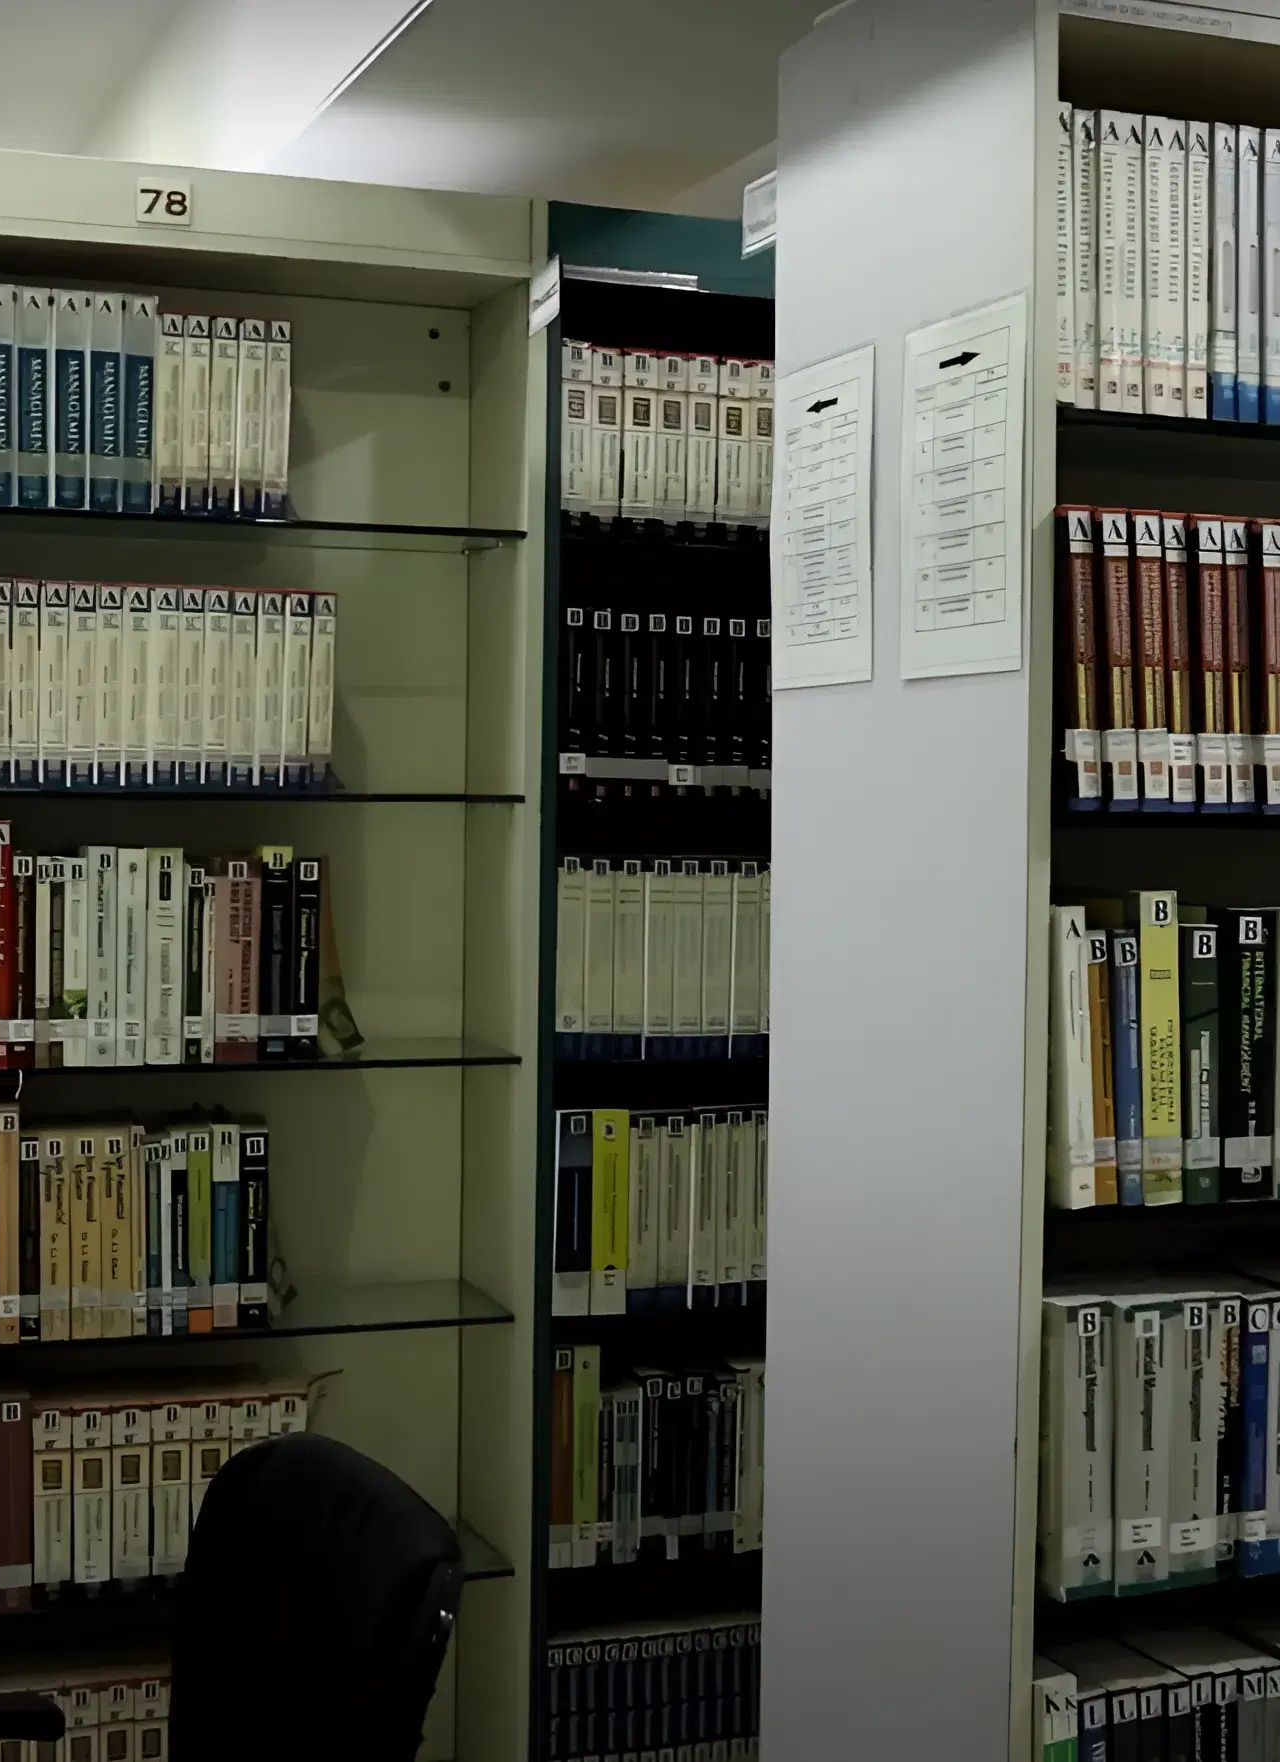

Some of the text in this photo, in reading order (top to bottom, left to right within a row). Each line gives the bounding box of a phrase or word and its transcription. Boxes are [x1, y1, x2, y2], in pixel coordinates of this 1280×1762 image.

[140, 188, 188, 216] 78
[30, 295, 40, 309] A
[64, 297, 76, 312] A
[101, 300, 112, 313] A
[137, 302, 148, 317] A
[193, 320, 205, 334] A
[220, 321, 232, 336] A
[250, 324, 261, 337] A
[1108, 519, 1123, 539] A
[1139, 521, 1156, 540] A
[1167, 525, 1184, 544] A
[1203, 527, 1218, 546] A
[1232, 529, 1245, 547] A
[49, 588, 62, 602] A
[76, 588, 91, 605] A
[130, 590, 146, 606] A
[159, 592, 174, 607] A
[185, 593, 200, 608] A
[239, 596, 250, 611] A
[266, 596, 278, 612] A
[294, 596, 308, 612] A
[1155, 901, 1167, 920] B
[1067, 919, 1081, 938] A
[1245, 921, 1257, 940] B
[1092, 940, 1105, 959] B
[1122, 942, 1135, 962] B
[1199, 935, 1211, 954] B
[1083, 1313, 1097, 1333] B
[1190, 1306, 1203, 1326] B
[1224, 1305, 1237, 1324] B
[1251, 1309, 1267, 1328] C
[1045, 1692, 1060, 1711] K
